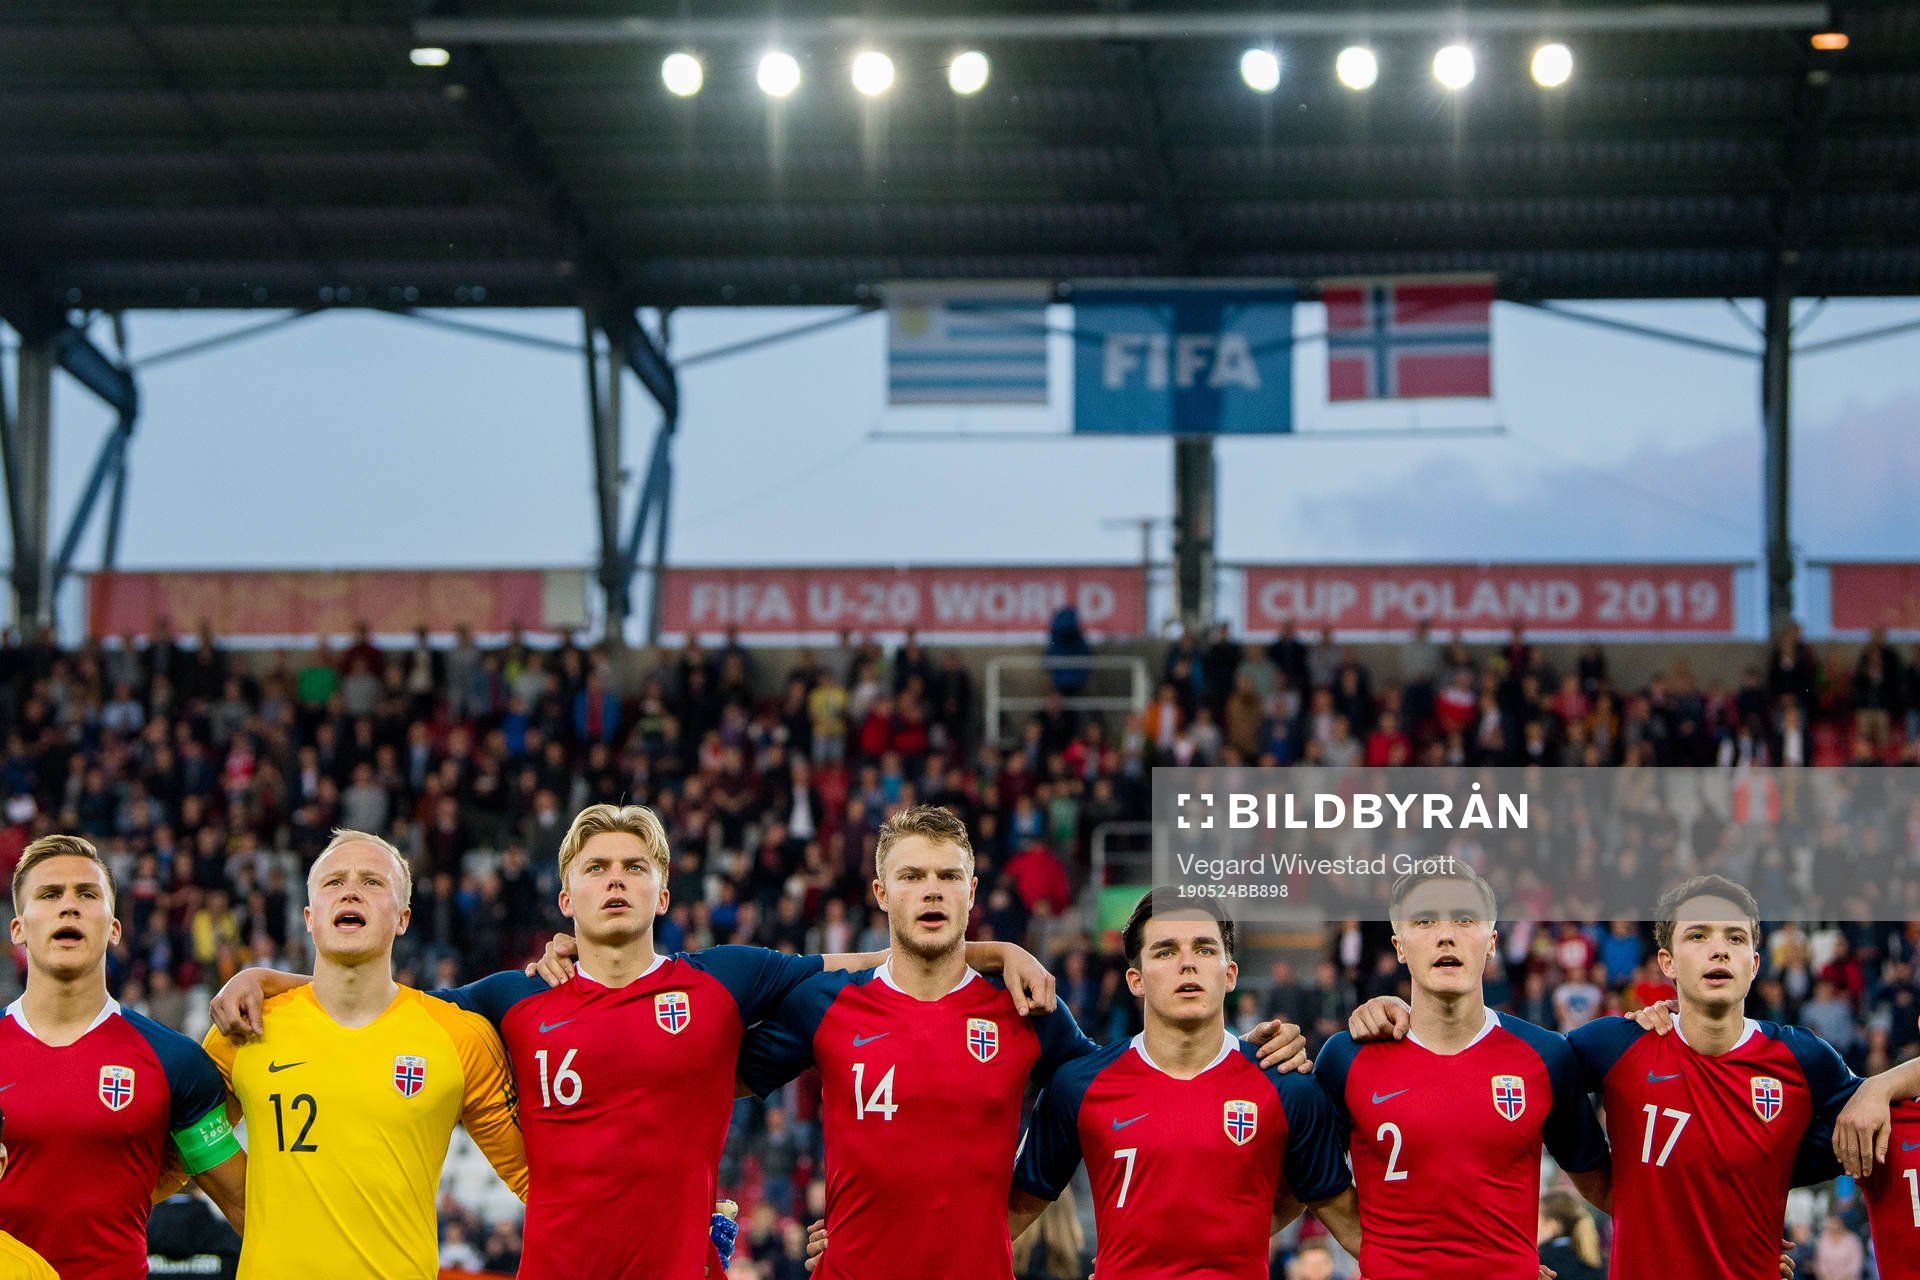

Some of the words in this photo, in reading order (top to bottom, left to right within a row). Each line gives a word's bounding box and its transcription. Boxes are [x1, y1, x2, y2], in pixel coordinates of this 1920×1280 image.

[1102, 333, 1260, 391] FIFA
[689, 582, 793, 623] FIFA
[807, 582, 919, 623] U-20
[931, 582, 1115, 623] WORLD
[1259, 579, 1357, 621] CUP
[1371, 579, 1582, 621] POLAND
[1597, 579, 1719, 622] 2019
[534, 1048, 583, 1108] 16
[852, 1062, 899, 1121] 14
[268, 1093, 318, 1153] 12
[1376, 1121, 1409, 1182] 2
[1641, 1103, 1692, 1167] 17
[1113, 1147, 1138, 1208] 7
